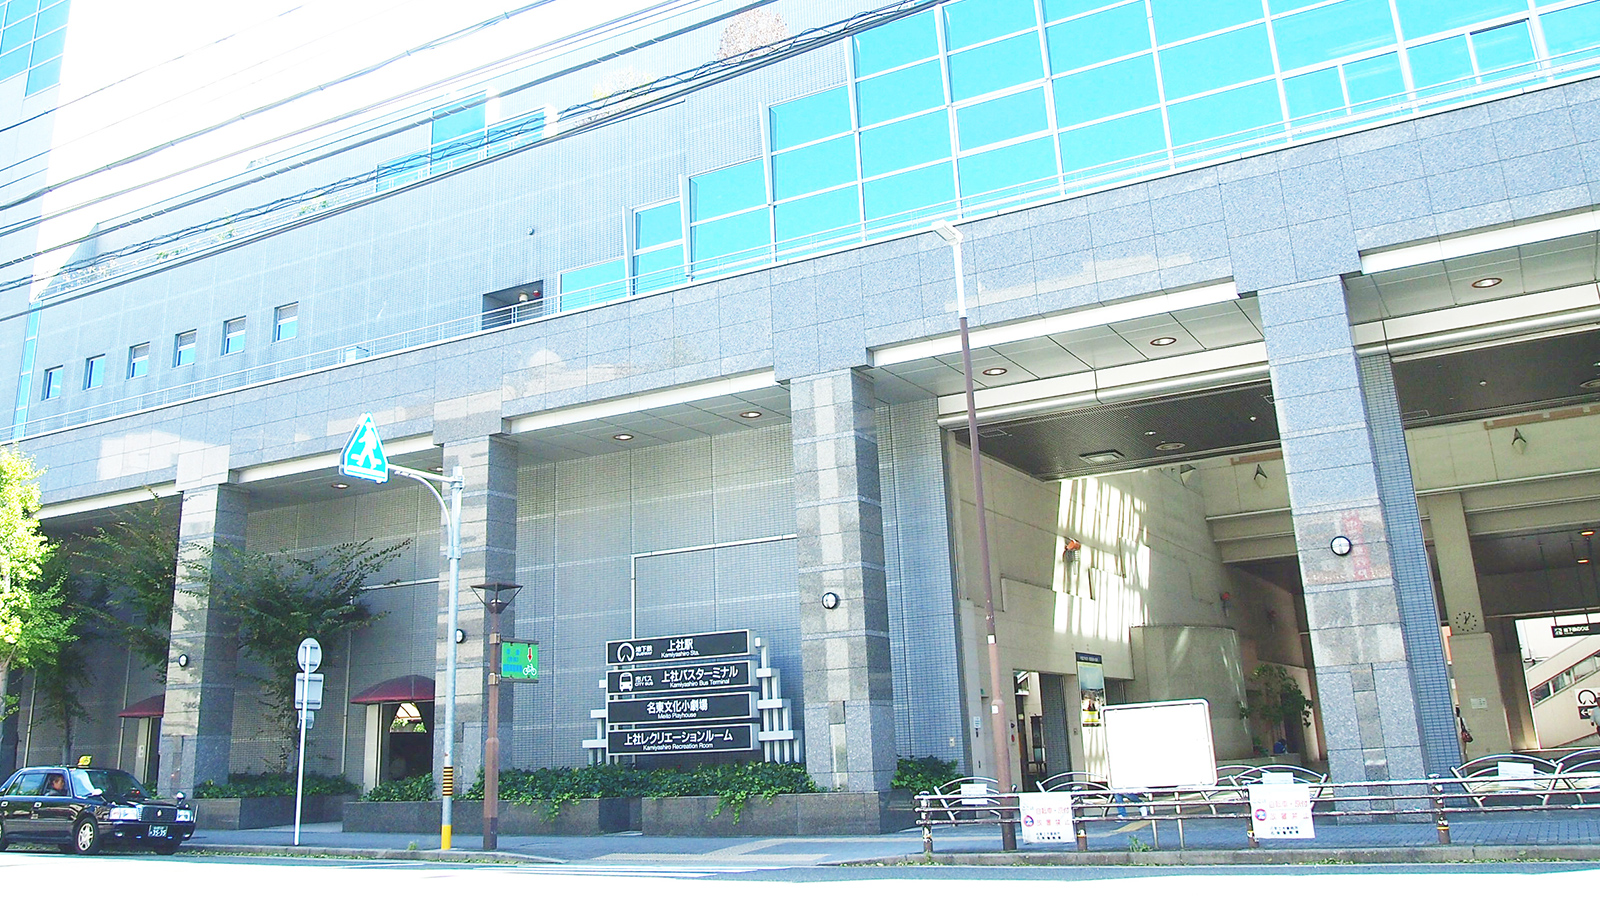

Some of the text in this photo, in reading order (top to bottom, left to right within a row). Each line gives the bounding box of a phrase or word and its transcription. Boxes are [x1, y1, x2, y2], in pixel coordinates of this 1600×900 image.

[667, 638, 693, 651] 上社駅
[660, 651, 690, 659] Kamiyashiro
[661, 666, 738, 682] 上社バスターミナル
[710, 678, 730, 686] Terminal
[646, 699, 708, 713] 名東文化小劇場
[624, 729, 733, 745] 上社レクリエーションルーム
